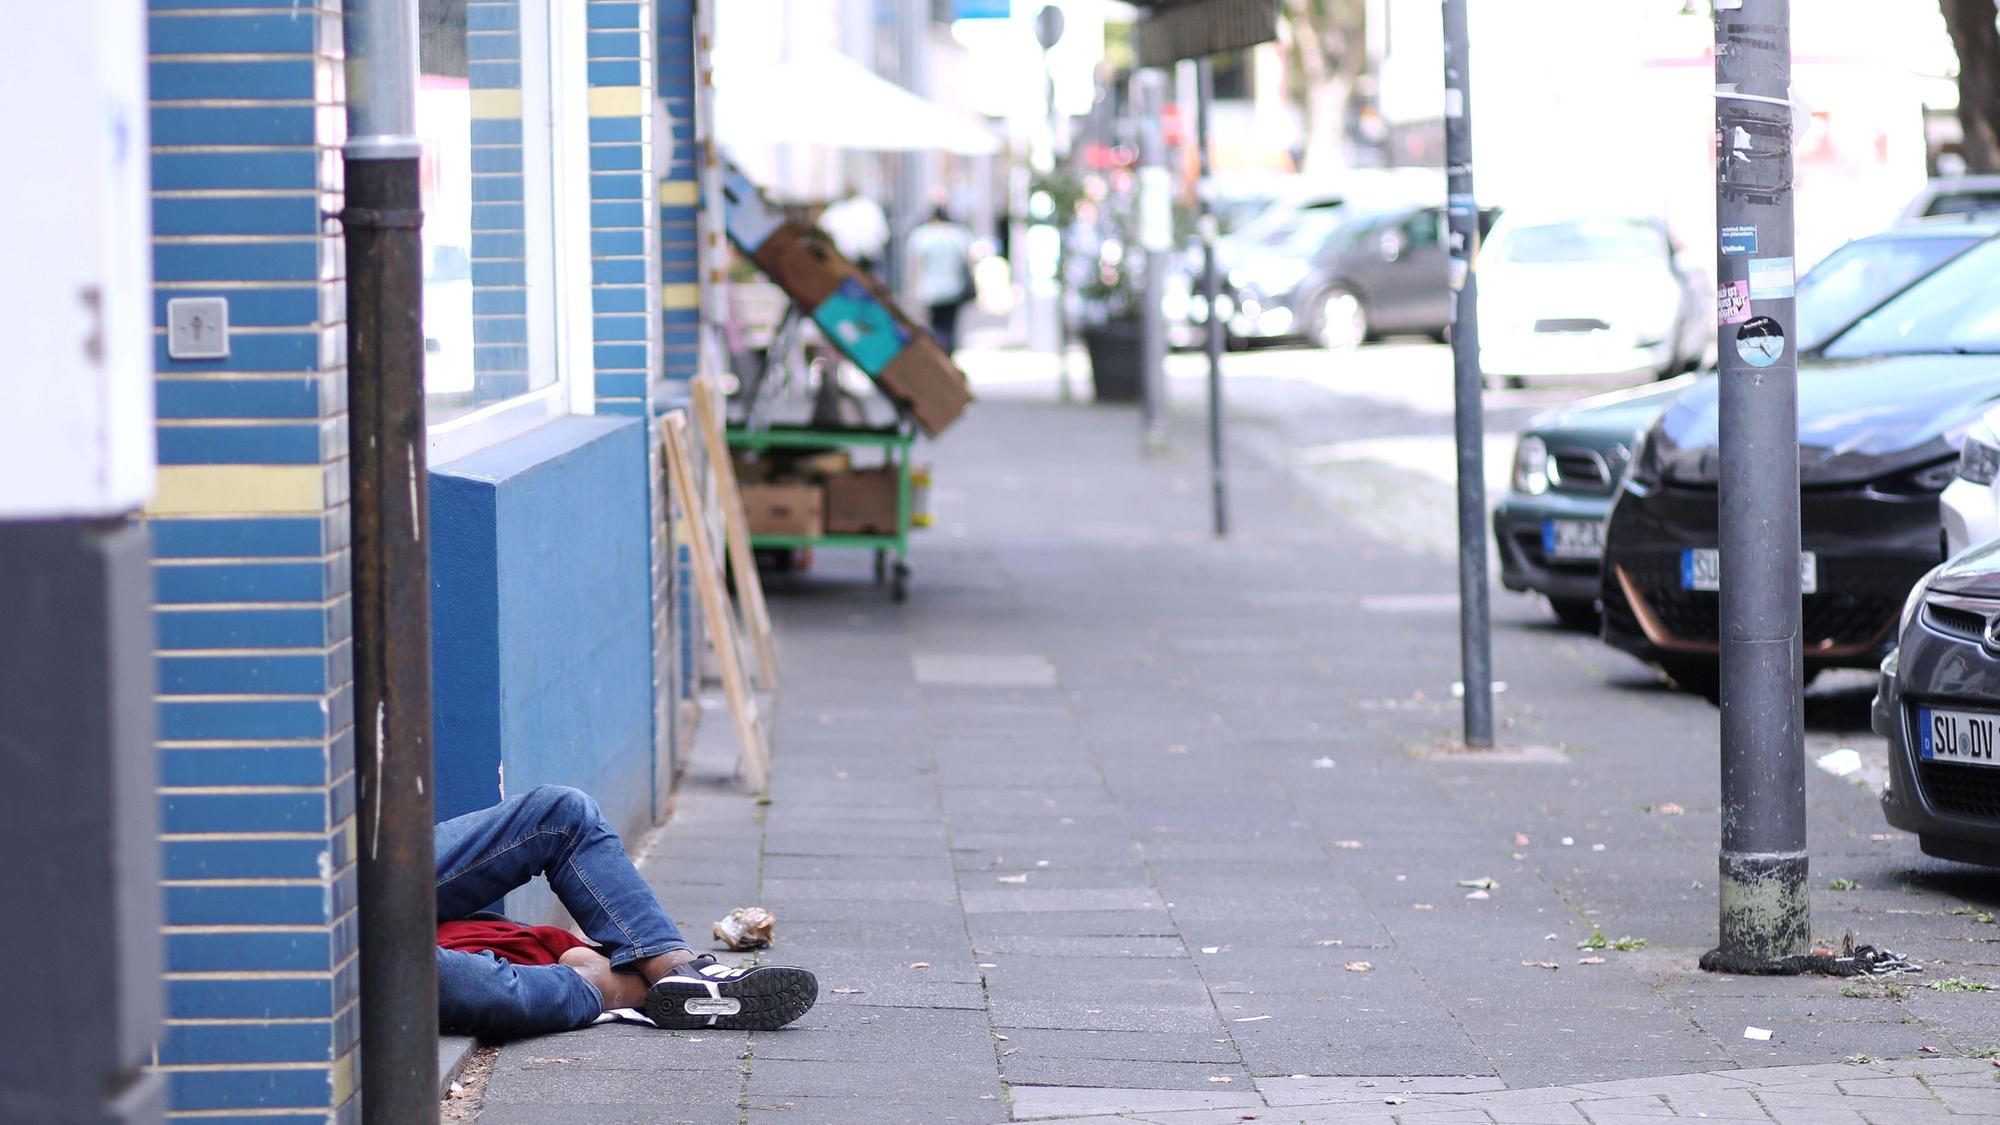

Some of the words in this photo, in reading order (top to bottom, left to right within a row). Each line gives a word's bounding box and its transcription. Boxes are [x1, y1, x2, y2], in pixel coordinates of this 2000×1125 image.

[1695, 556, 1719, 582] SU
[1934, 715, 1958, 756] SU
[1969, 719, 1993, 759] DV
